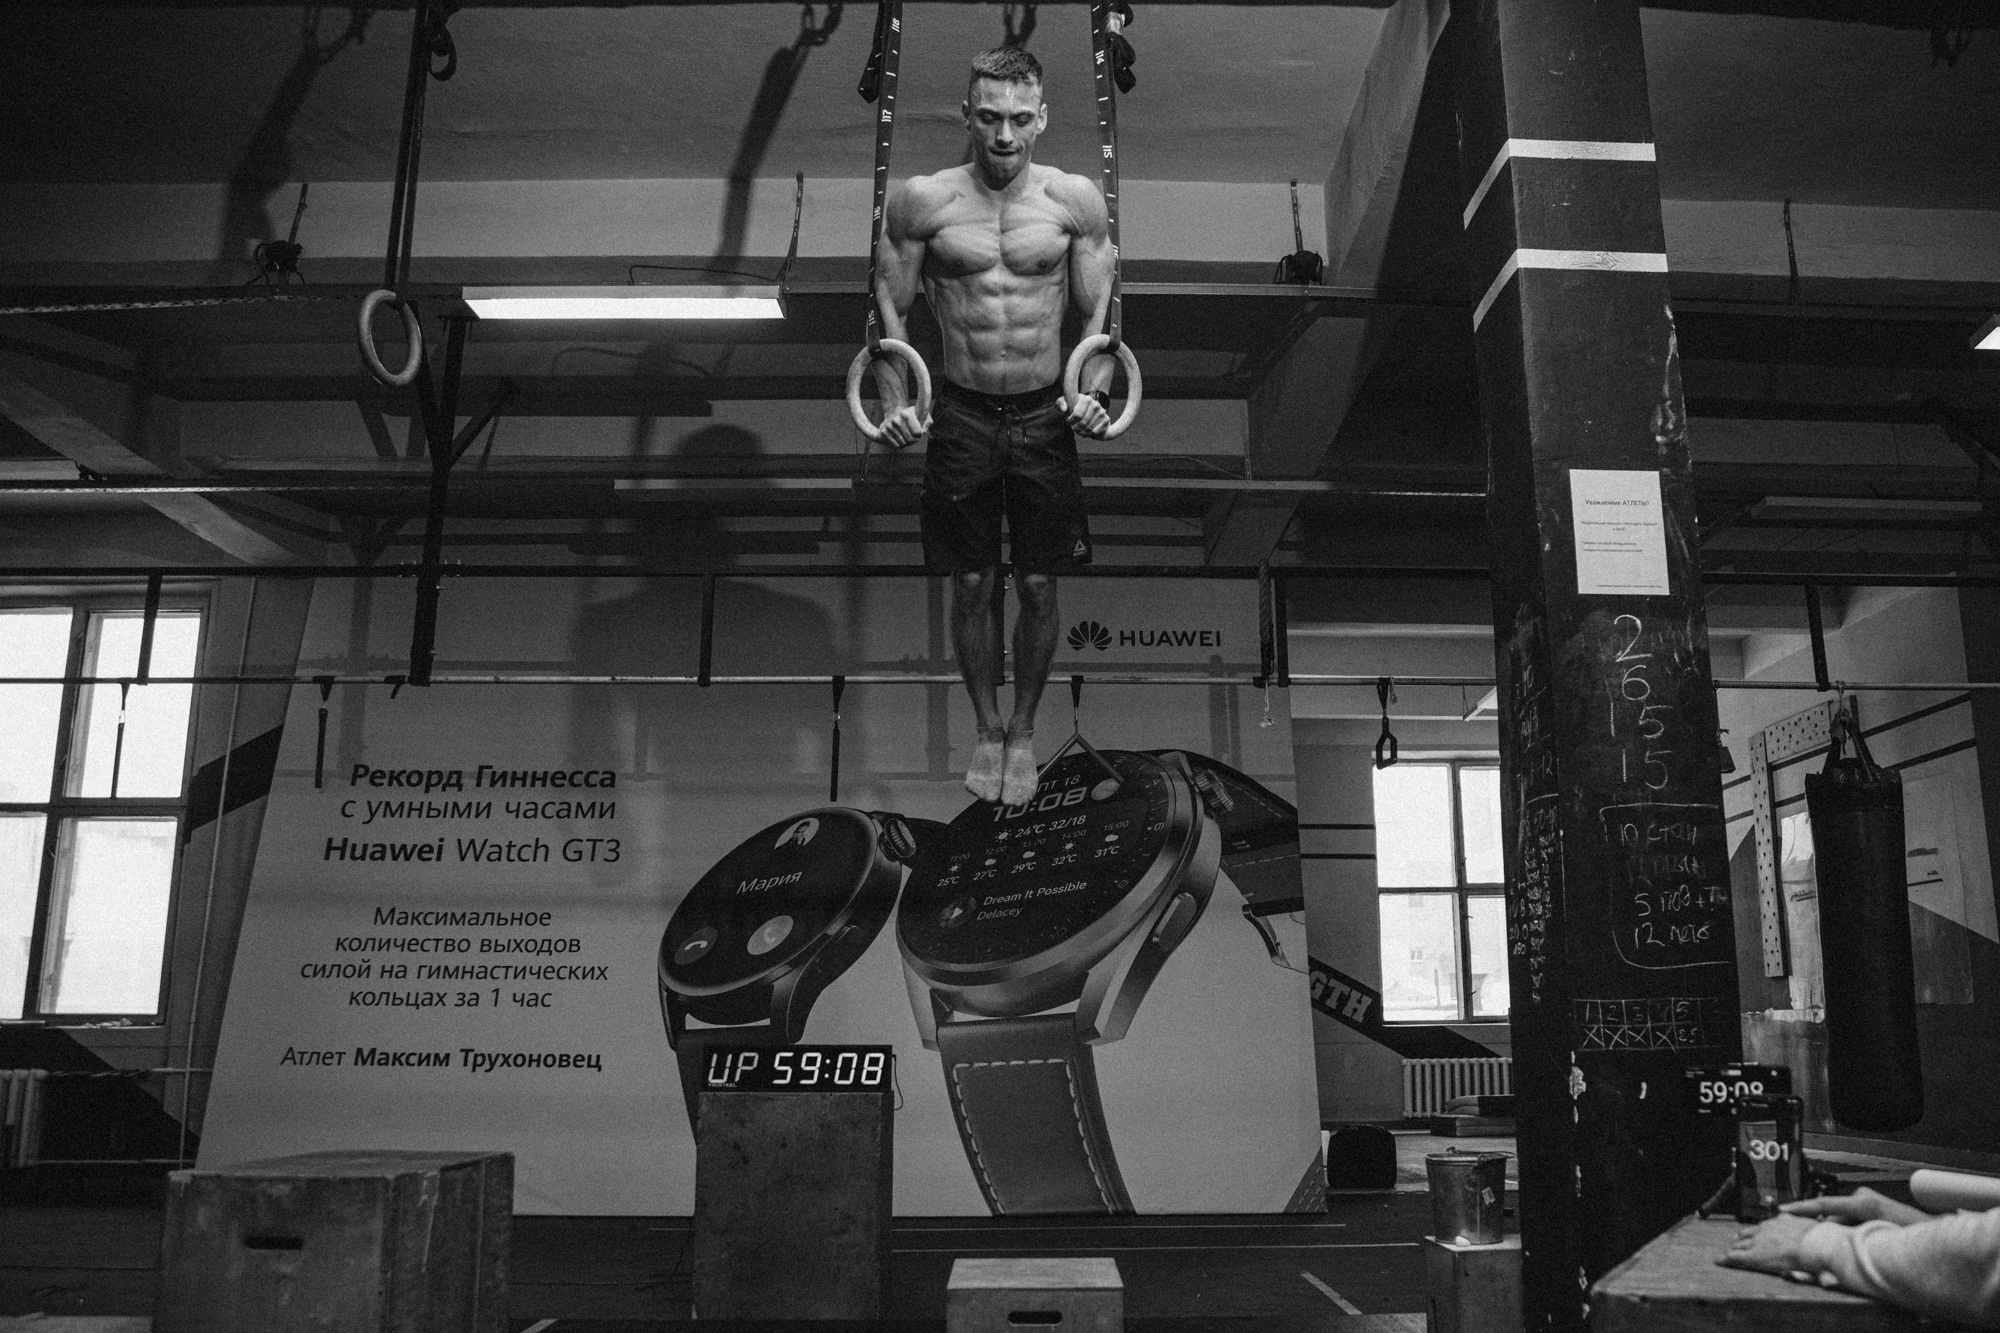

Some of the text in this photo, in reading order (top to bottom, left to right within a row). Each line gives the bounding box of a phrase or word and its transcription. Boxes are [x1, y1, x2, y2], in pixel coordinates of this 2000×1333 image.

[881, 109, 892, 122] 117
[1119, 630, 1221, 647] HUAWEI
[1613, 614, 1652, 663] 2
[1622, 664, 1650, 701] 6
[350, 764, 617, 793] Рекорд Гиннесса
[1064, 774, 1081, 787] 18
[341, 799, 616, 825] с умными часами
[1049, 814, 1087, 831] 32/18
[324, 837, 622, 863] Huawei Watch GT3
[736, 871, 803, 895] Мария
[983, 880, 1088, 906] Dream It Possible
[374, 907, 551, 927] Максимальное
[976, 906, 1024, 921] Delacey
[335, 935, 582, 957] количество выходов
[300, 958, 610, 981] силой на гимнастических
[348, 988, 553, 1010] кольцах за 1 час
[280, 1046, 603, 1073] Атлет Максим Трухоновец
[708, 1052, 885, 1085] UP 59:08
[1749, 1139, 1789, 1162] 301
